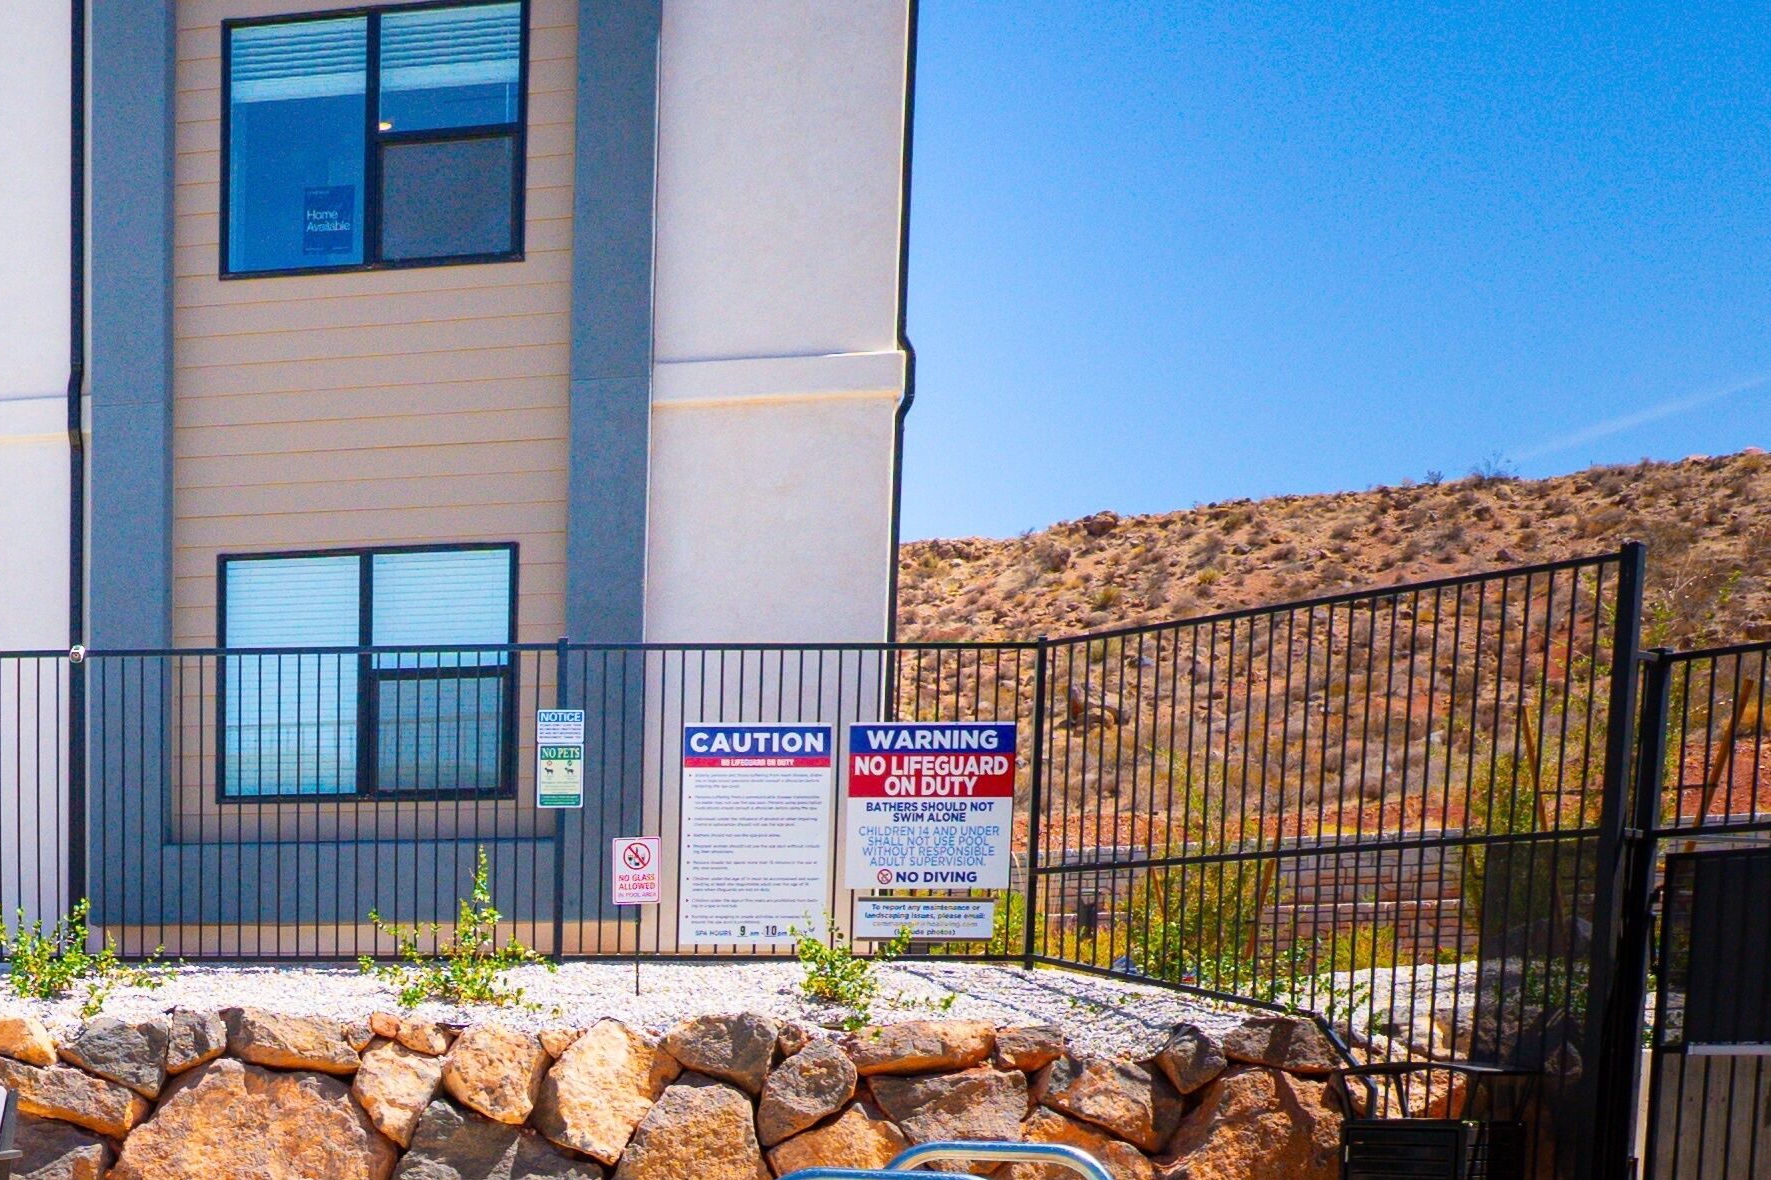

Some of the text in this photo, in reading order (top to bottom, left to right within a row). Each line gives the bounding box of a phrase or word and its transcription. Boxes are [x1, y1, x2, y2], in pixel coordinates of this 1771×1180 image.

[306, 210, 338, 220] Home
[306, 221, 351, 232] Available
[540, 712, 581, 722] NOTICE
[690, 732, 824, 753] CAUTION
[866, 730, 998, 750] WARNING
[542, 747, 580, 758] NO PETS
[854, 756, 1009, 776] NO LIFEGUARD
[884, 776, 978, 796] ON DUTY
[866, 802, 994, 812] BATHERS SHOULD NOT
[893, 813, 966, 822] SWIM ALONE
[858, 826, 1000, 836] CHILDREN 14 AND UNDER
[868, 836, 989, 846] SHALL NOT USE POOL
[862, 846, 995, 856] WITHOUT RESPONSIBLE
[870, 856, 986, 866] ADULT SUPERVISION.
[619, 874, 630, 882] NO
[896, 872, 977, 882] NO DIVING
[619, 882, 655, 890] ALLOWED
[740, 925, 746, 936] 9
[766, 925, 777, 936] 10
